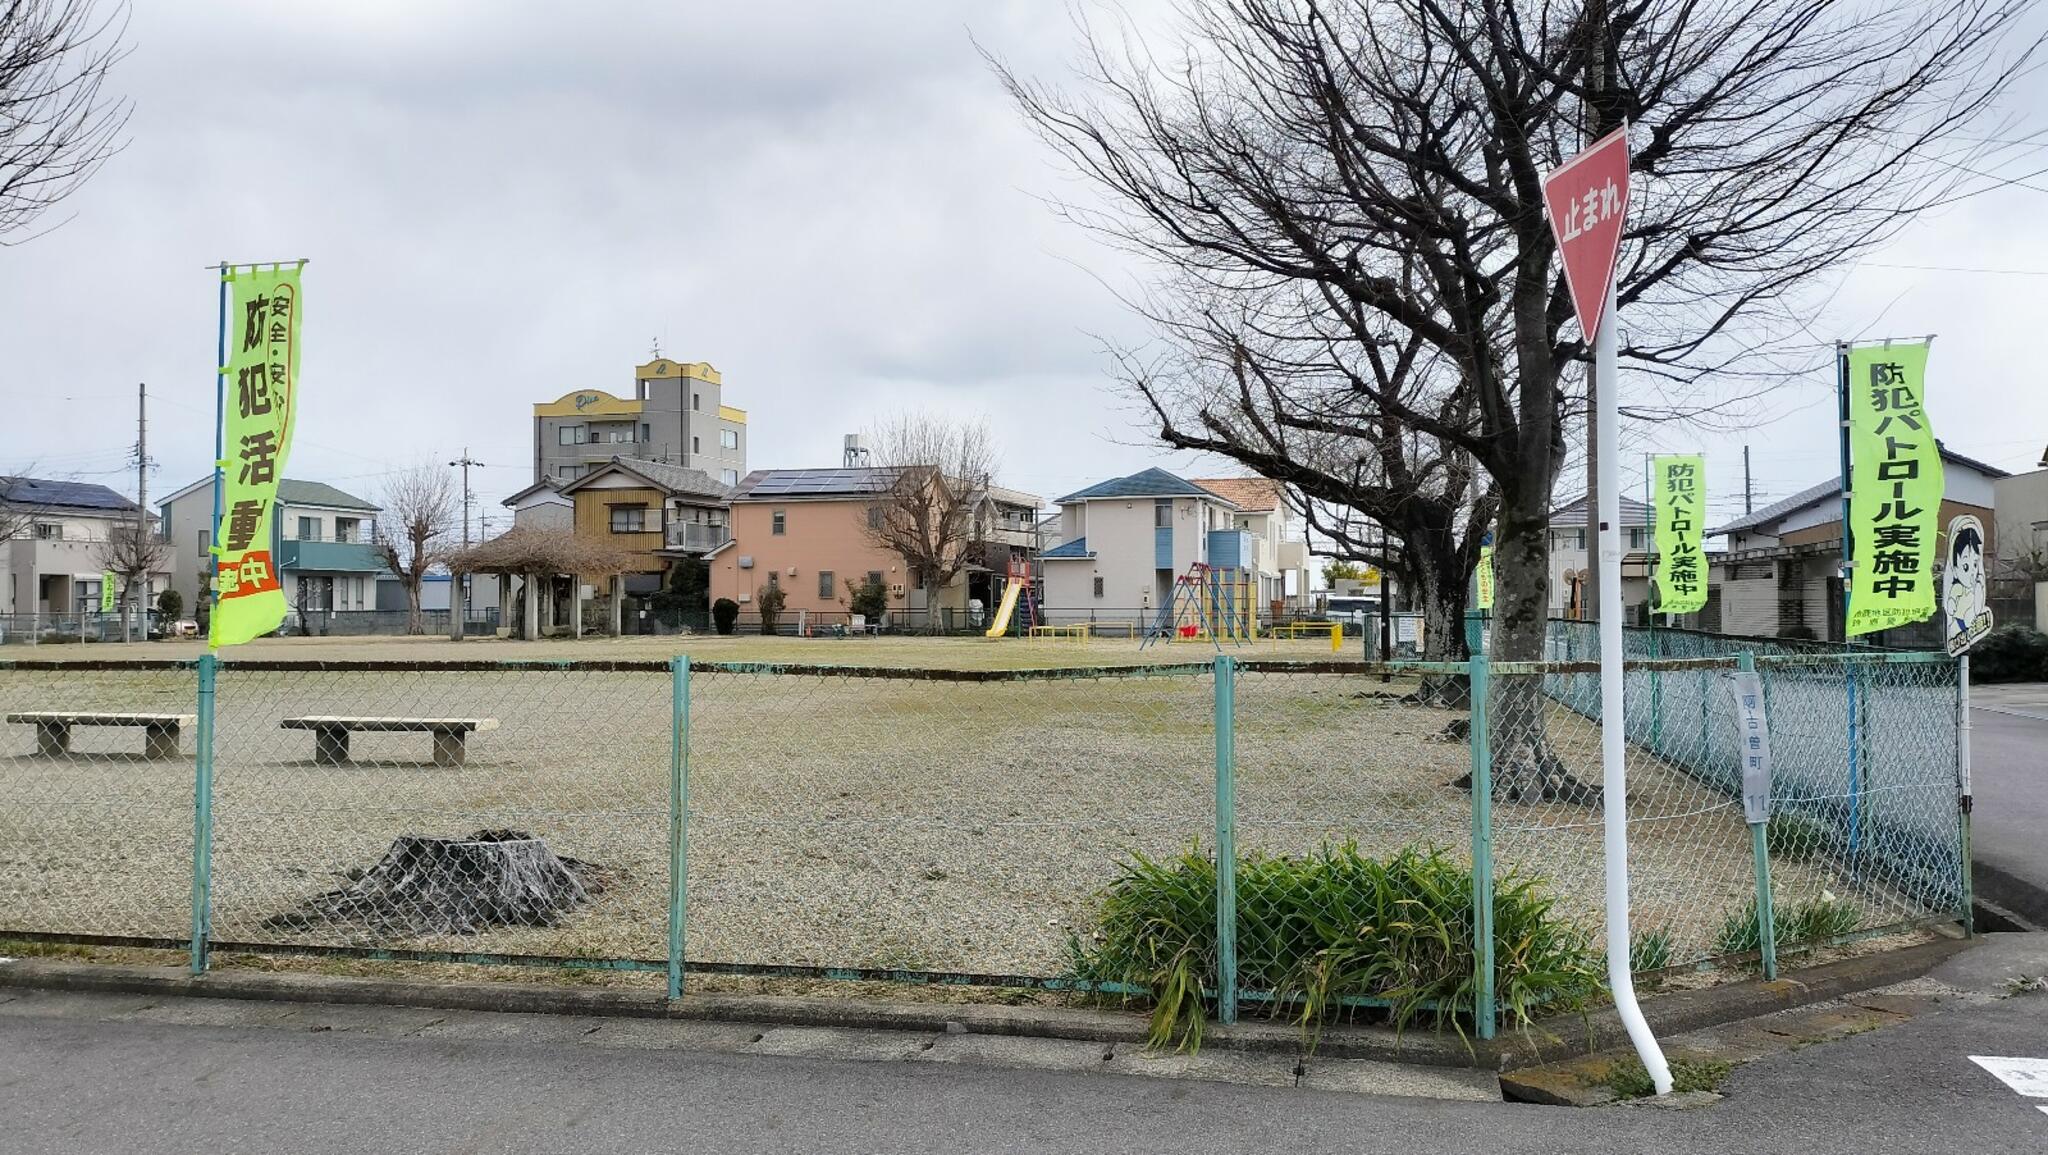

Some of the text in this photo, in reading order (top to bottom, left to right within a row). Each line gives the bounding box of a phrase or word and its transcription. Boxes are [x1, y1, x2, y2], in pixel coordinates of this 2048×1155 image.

[1562, 177, 1621, 243] 止まれ
[1667, 463, 1698, 596] 防犯パトロール実施中
[1870, 362, 1923, 599] 防犯パトロール実施中
[1748, 794, 1766, 812] 11
